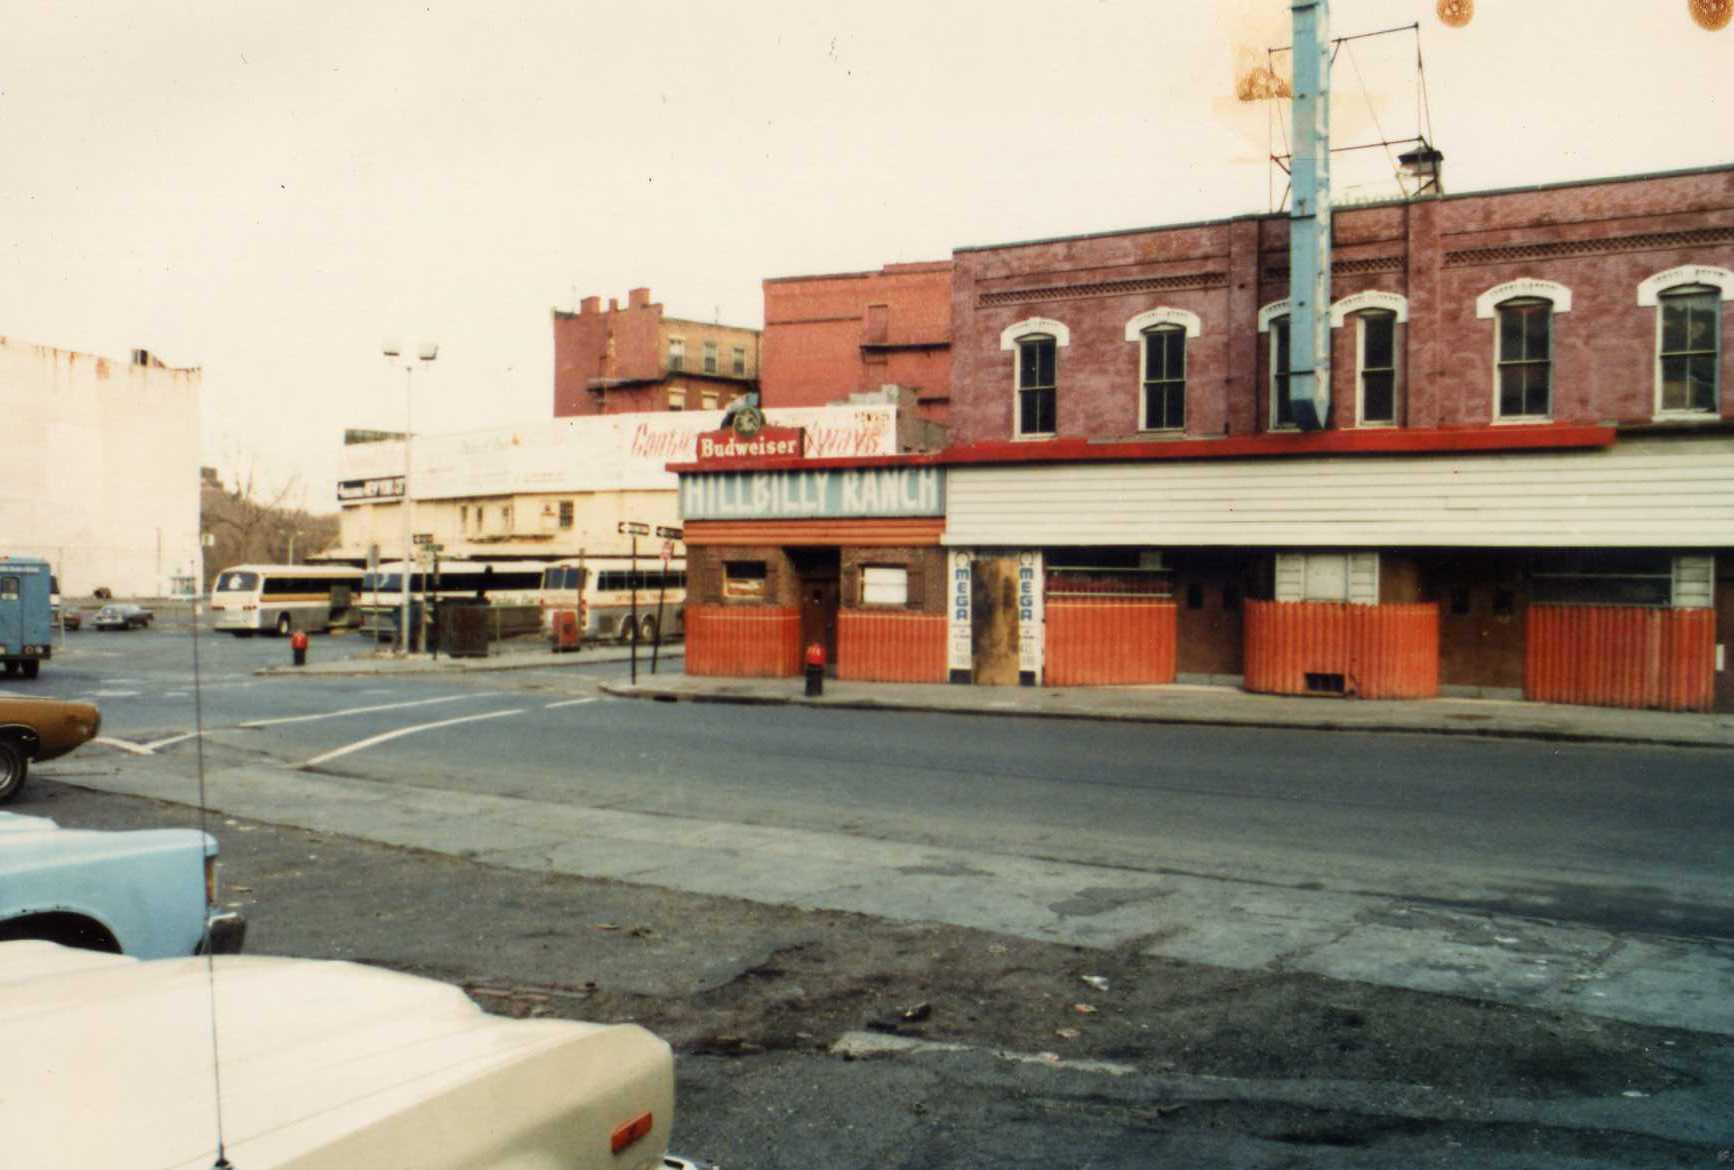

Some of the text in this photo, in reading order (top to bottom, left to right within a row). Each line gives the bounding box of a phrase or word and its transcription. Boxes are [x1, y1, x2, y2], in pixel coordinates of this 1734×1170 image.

[701, 437, 797, 457] Budweiser
[684, 470, 938, 514] HILLBILLY RANCH
